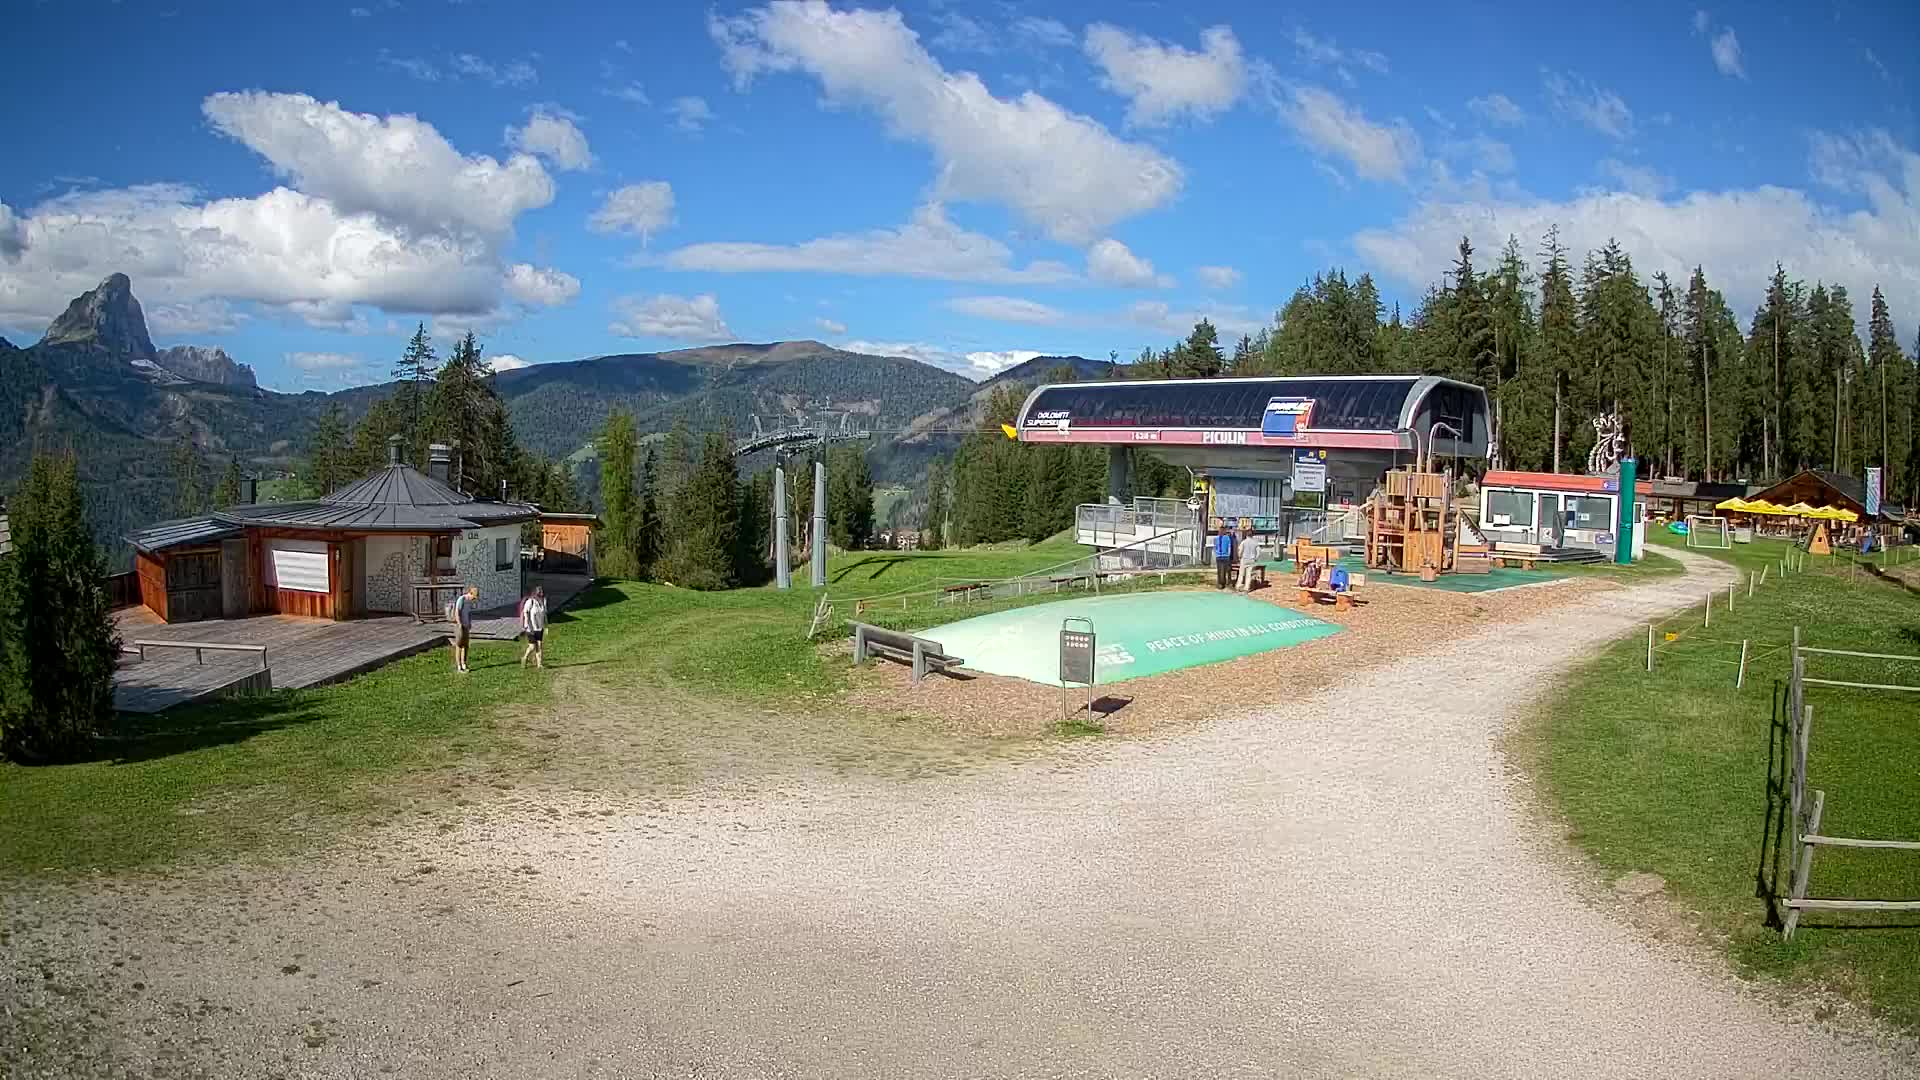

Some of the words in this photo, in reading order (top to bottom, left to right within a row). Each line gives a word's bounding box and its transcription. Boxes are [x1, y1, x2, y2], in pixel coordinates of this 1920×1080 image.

[1037, 411, 1069, 419] DOLOMITI
[1202, 431, 1247, 444] PICULIN
[1144, 636, 1189, 653] PEACE
[1188, 632, 1207, 646] OF
[1204, 629, 1236, 641] MIND
[1233, 626, 1249, 638] IN
[1247, 623, 1269, 636] ALL
